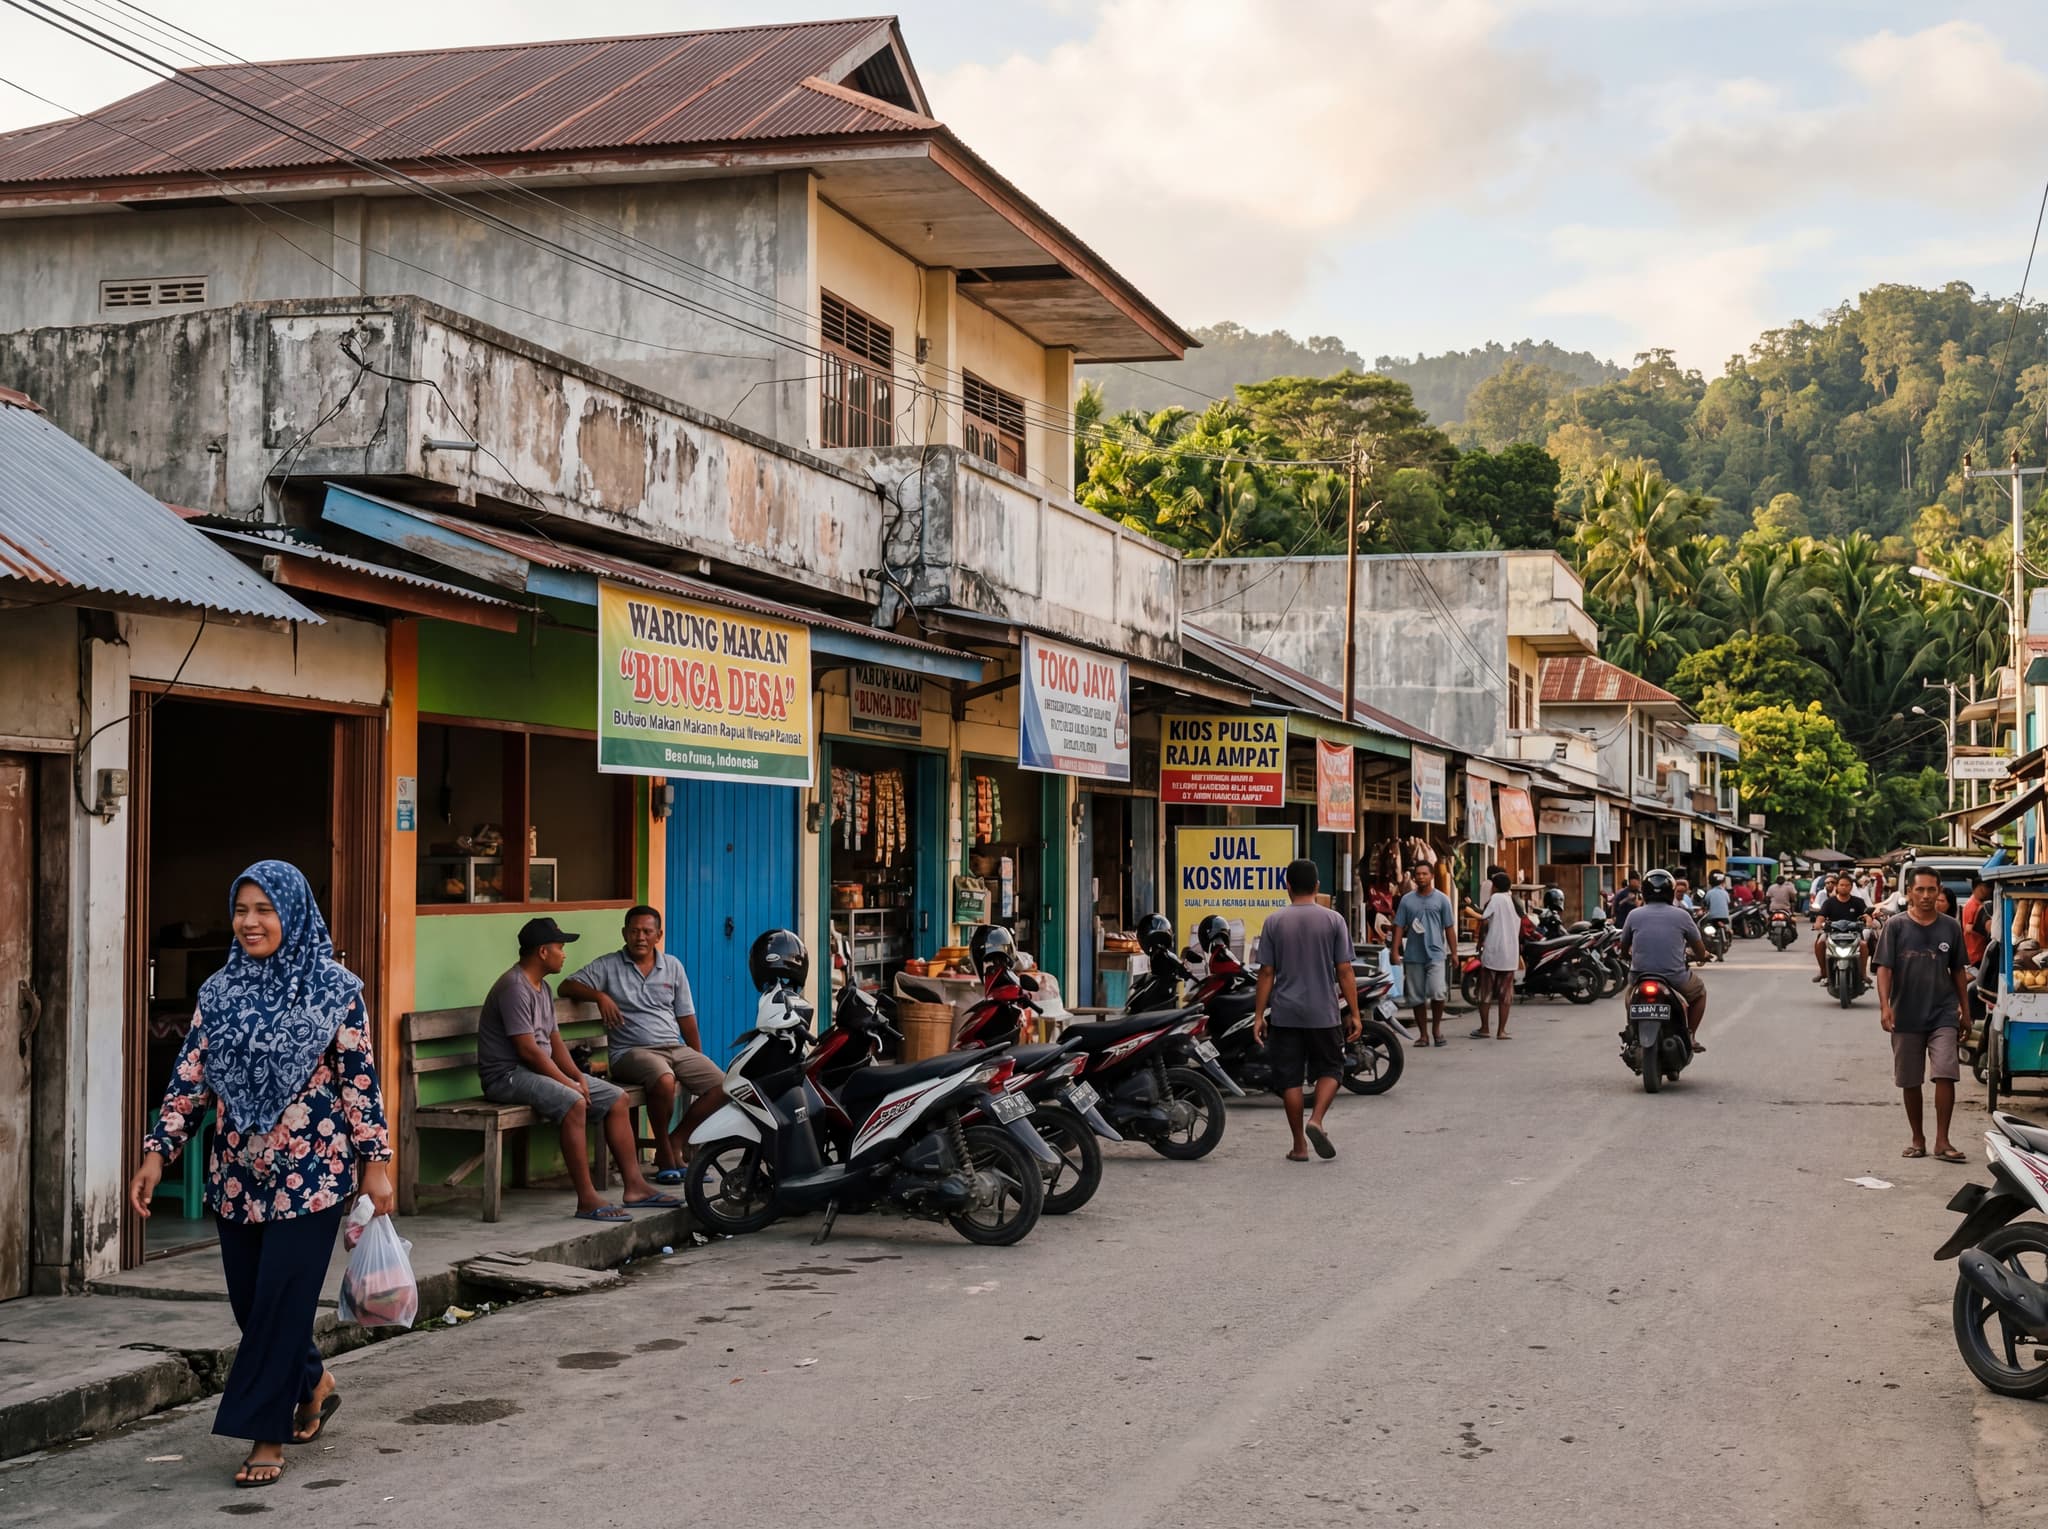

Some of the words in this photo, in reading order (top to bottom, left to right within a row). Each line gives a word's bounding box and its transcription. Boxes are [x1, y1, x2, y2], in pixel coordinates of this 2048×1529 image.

[628, 602, 718, 652] WARUNG
[722, 622, 788, 664] MAKAN
[620, 649, 723, 712] “BUNGA
[727, 667, 795, 720] DESA”
[1038, 648, 1079, 695] TOKO
[1083, 661, 1117, 703] JAYA
[649, 714, 681, 732] Makan
[683, 718, 718, 736] Makann
[1170, 720, 1212, 741] KIOS
[1218, 721, 1277, 743] PULSA
[717, 752, 759, 769] Indonesia
[1166, 744, 1211, 766] RAJA
[1216, 746, 1280, 768] AMPAT
[1210, 836, 1260, 860] JUAL
[1183, 866, 1288, 890] KOSMETIK
